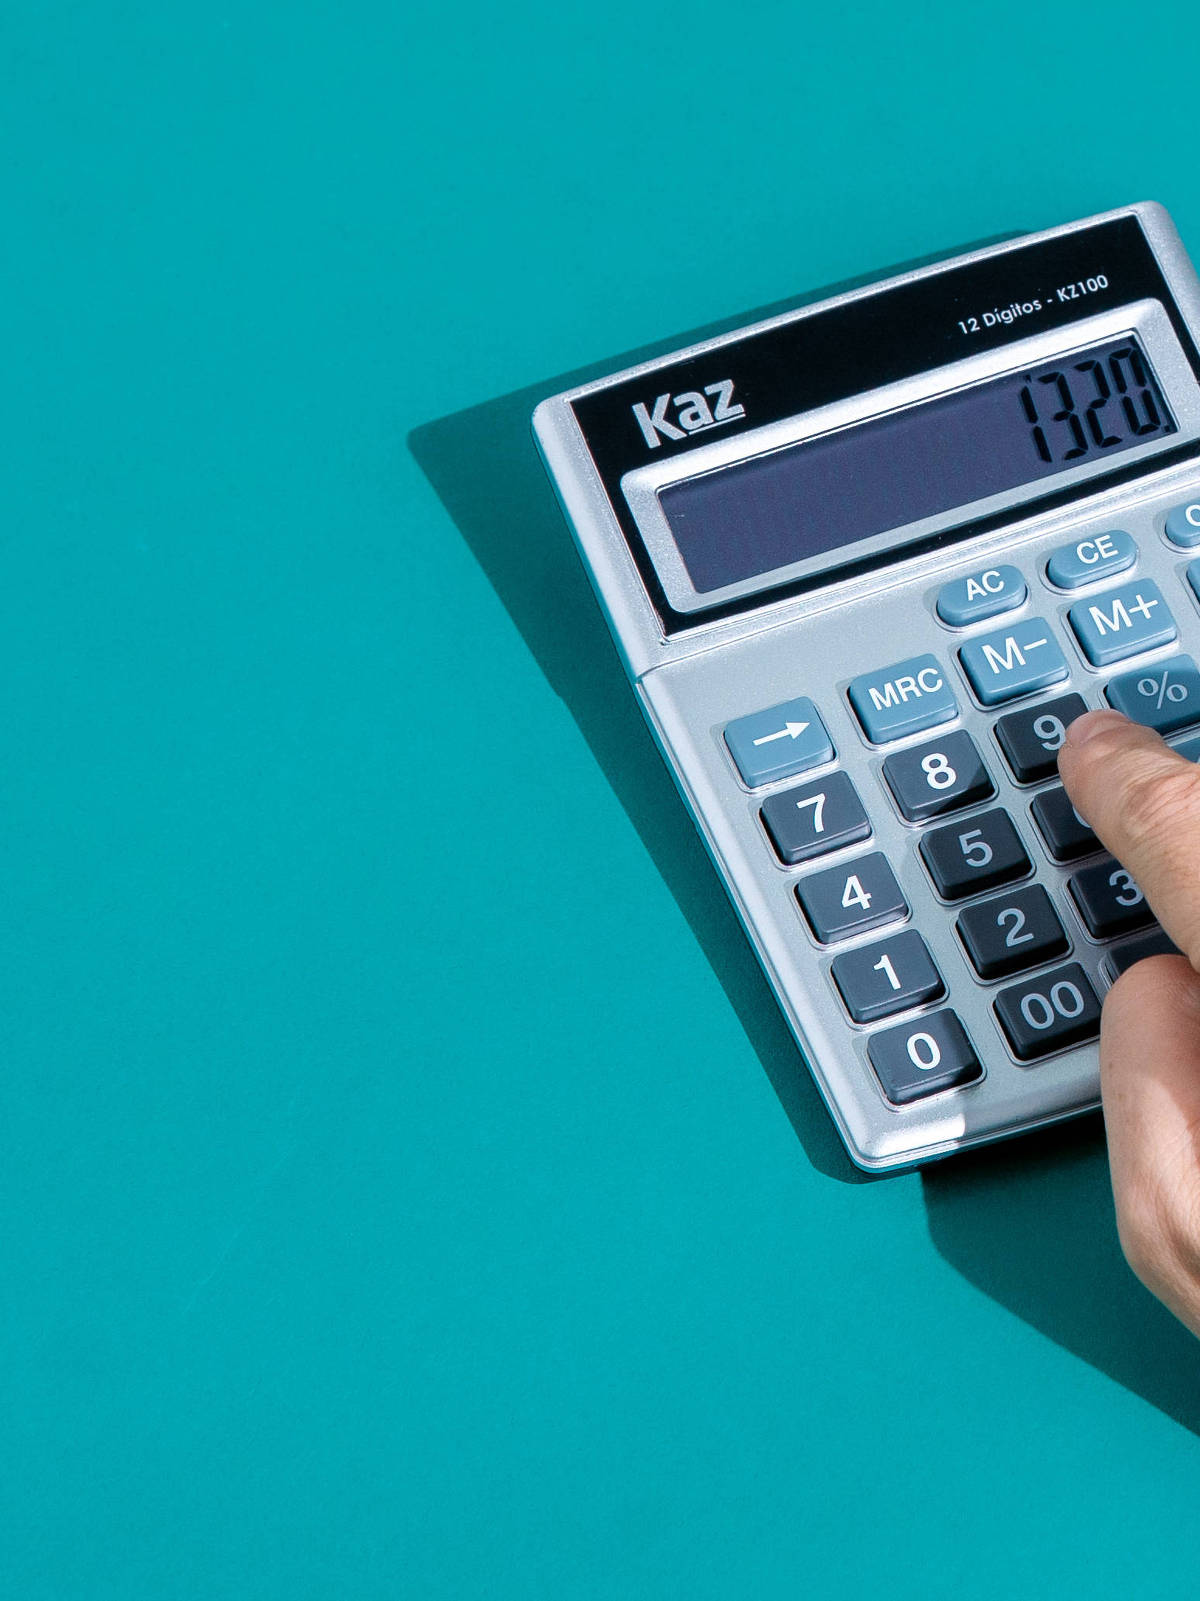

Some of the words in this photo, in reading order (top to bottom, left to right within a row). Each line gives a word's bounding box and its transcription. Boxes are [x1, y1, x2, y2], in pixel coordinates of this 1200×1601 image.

[959, 318, 980, 335] 12
[982, 299, 1043, 327] Dígitos
[1055, 275, 1110, 302] KZ100
[631, 379, 746, 449] Kaz
[1076, 535, 1118, 565] CE
[965, 571, 1005, 601] AC
[1090, 595, 1158, 635] M+
[868, 667, 943, 711] MRC
[1137, 671, 1188, 709] %
[1033, 714, 1066, 751] 9
[920, 753, 958, 790] 8
[796, 794, 828, 834] 7
[957, 829, 993, 868] 5
[840, 875, 873, 911] 4
[1108, 868, 1144, 907] 3
[997, 907, 1035, 948] 2
[872, 954, 902, 991] 1
[1020, 980, 1085, 1030] 00
[906, 1032, 942, 1071] 0
